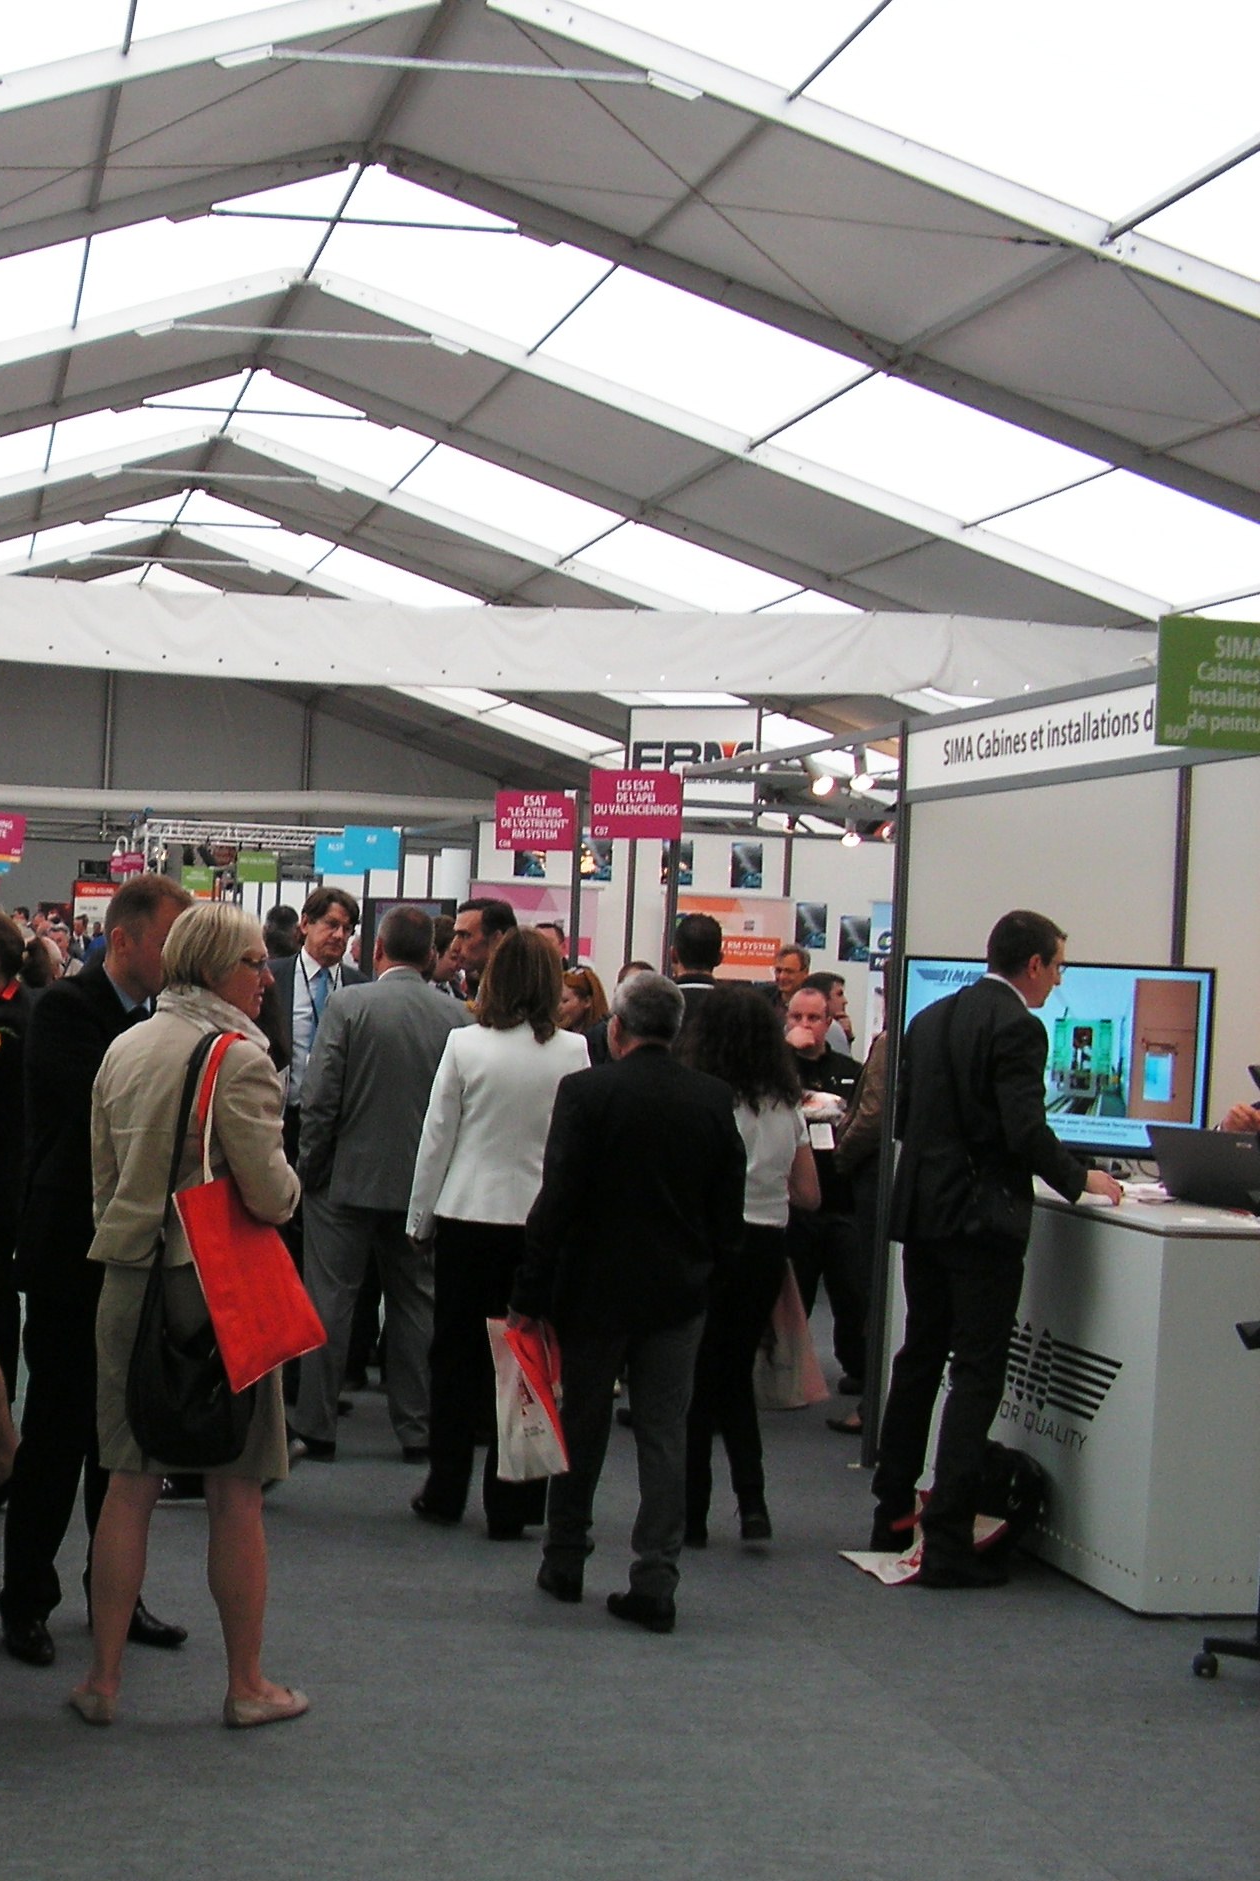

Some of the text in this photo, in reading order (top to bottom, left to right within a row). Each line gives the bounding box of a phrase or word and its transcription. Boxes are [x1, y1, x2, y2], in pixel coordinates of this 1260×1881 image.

[1197, 661, 1260, 684] Cabines
[1186, 709, 1207, 730] de
[943, 733, 974, 766] SIMA
[976, 727, 1028, 760] Cabines
[1030, 723, 1045, 752] et
[1046, 706, 1140, 749] installations
[616, 779, 656, 791] LES ESAT
[523, 794, 547, 807] ESAT
[615, 792, 629, 803] DE
[526, 807, 563, 819] ATELIERS
[593, 803, 678, 816] DU VALENCIENNOIS
[500, 817, 513, 829] DE
[526, 829, 557, 841] SYSTEM
[1023, 1411, 1088, 1453] QUALITY
